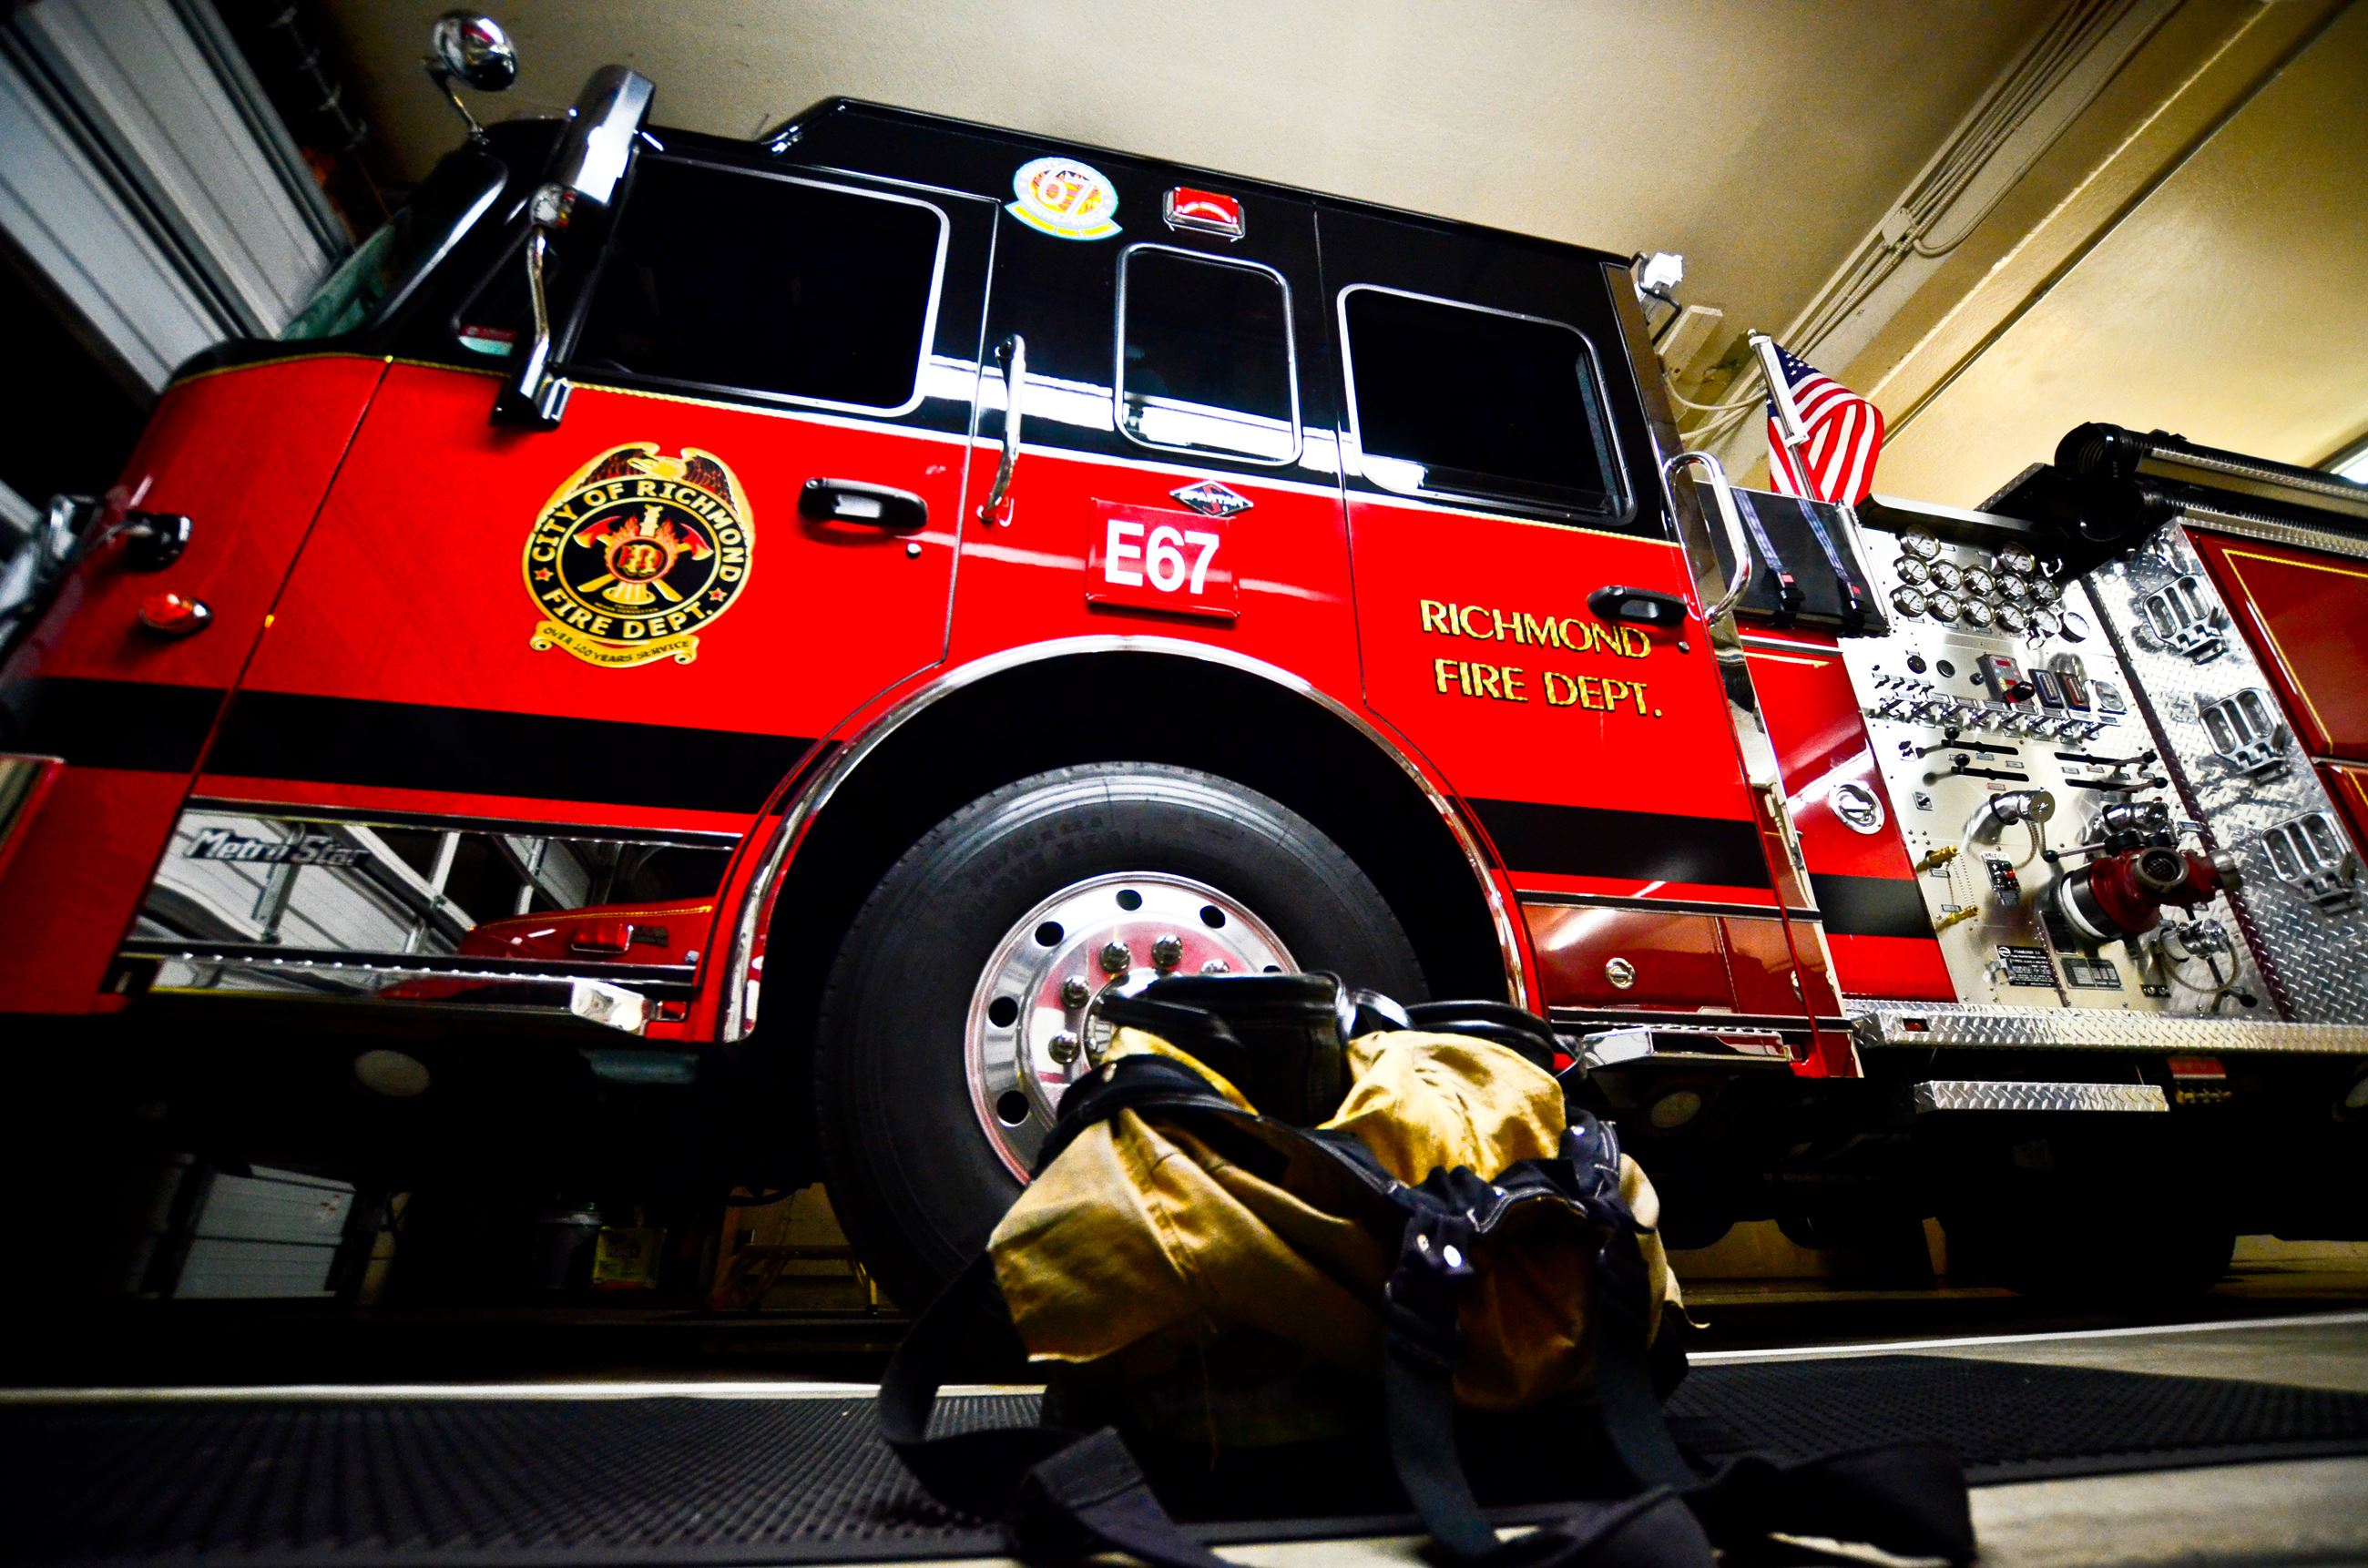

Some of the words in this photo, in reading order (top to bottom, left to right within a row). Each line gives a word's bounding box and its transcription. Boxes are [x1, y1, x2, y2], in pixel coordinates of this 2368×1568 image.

[1040, 164, 1095, 222] 67
[532, 504, 577, 562] CITY
[583, 483, 624, 506] OF
[637, 480, 745, 583] RICHMOND
[1105, 519, 1220, 595] E67
[542, 588, 612, 636] FIRE
[622, 602, 713, 638] DEPT.
[1420, 599, 1651, 657] RICHMOND
[543, 626, 572, 646] OVER
[573, 643, 593, 657] 100
[594, 653, 632, 663] YEARS
[637, 640, 689, 659] SERVICE
[1434, 658, 1528, 702] FIRE
[1543, 671, 1662, 717] DEPT.
